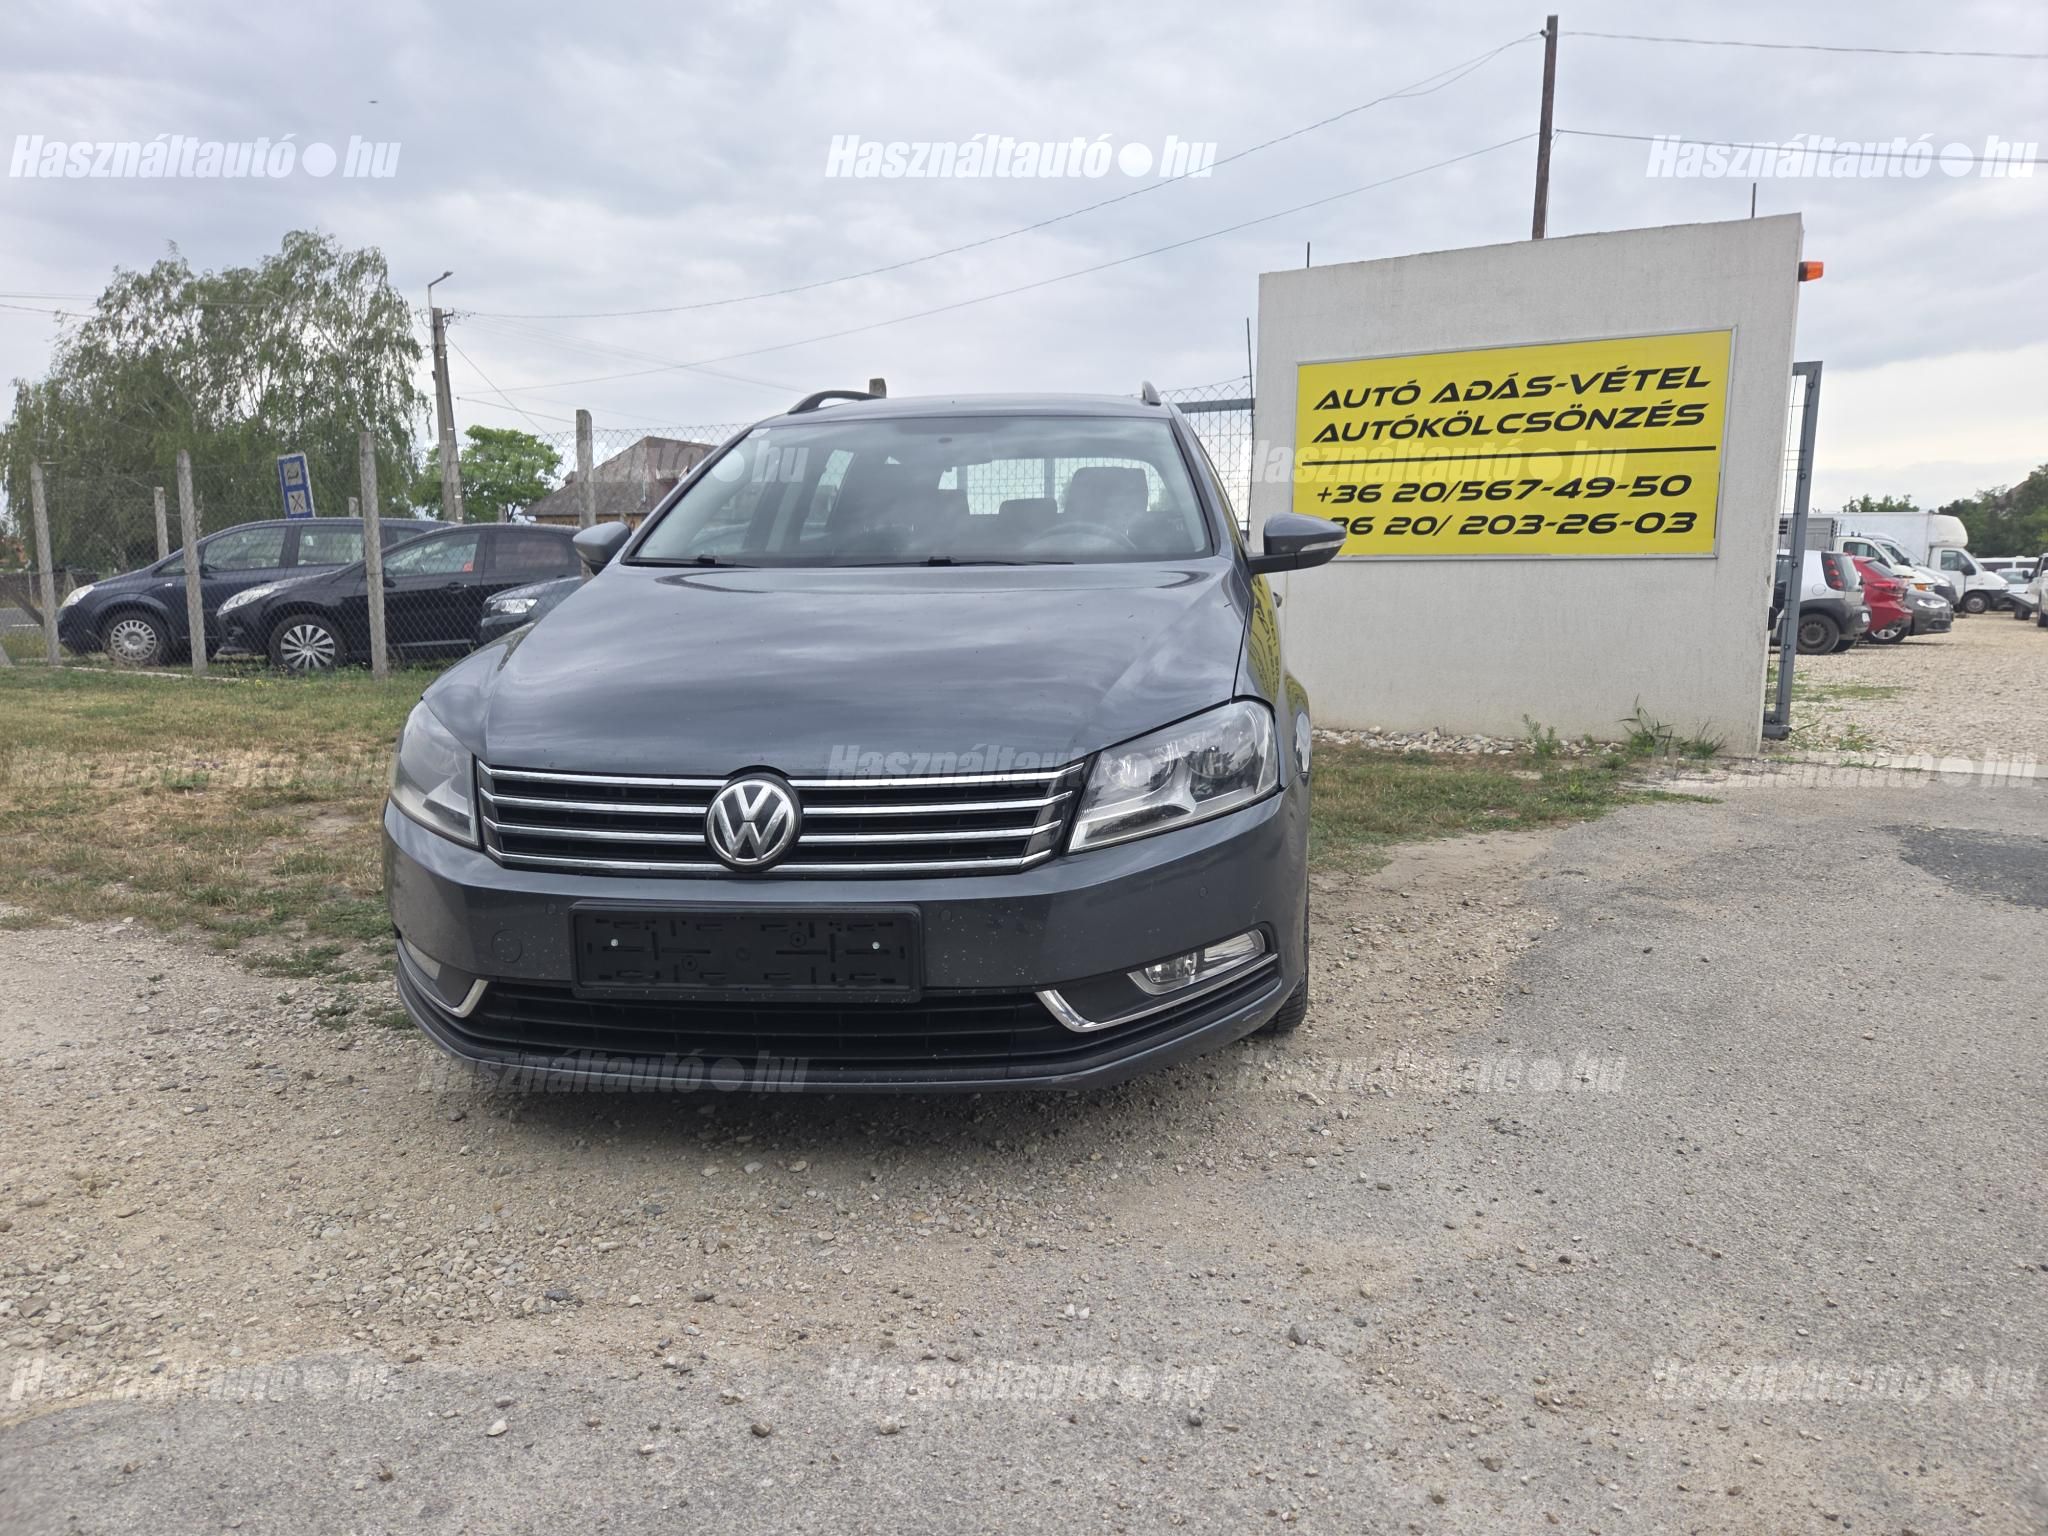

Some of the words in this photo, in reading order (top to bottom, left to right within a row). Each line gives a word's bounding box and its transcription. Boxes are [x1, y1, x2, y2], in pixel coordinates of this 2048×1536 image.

[1313, 379, 1421, 411] AUTÓ
[1429, 365, 1711, 404] ADÁS-VÉTEL
[1312, 399, 1709, 443] AUTÓKÖLCSÖNZÉS
[1317, 484, 1384, 504] +36
[1392, 474, 1692, 503] 20/567-49-50
[1383, 515, 1453, 536] 20/
[1458, 512, 1698, 535] 203-26-03
[708, 780, 794, 864] VW
